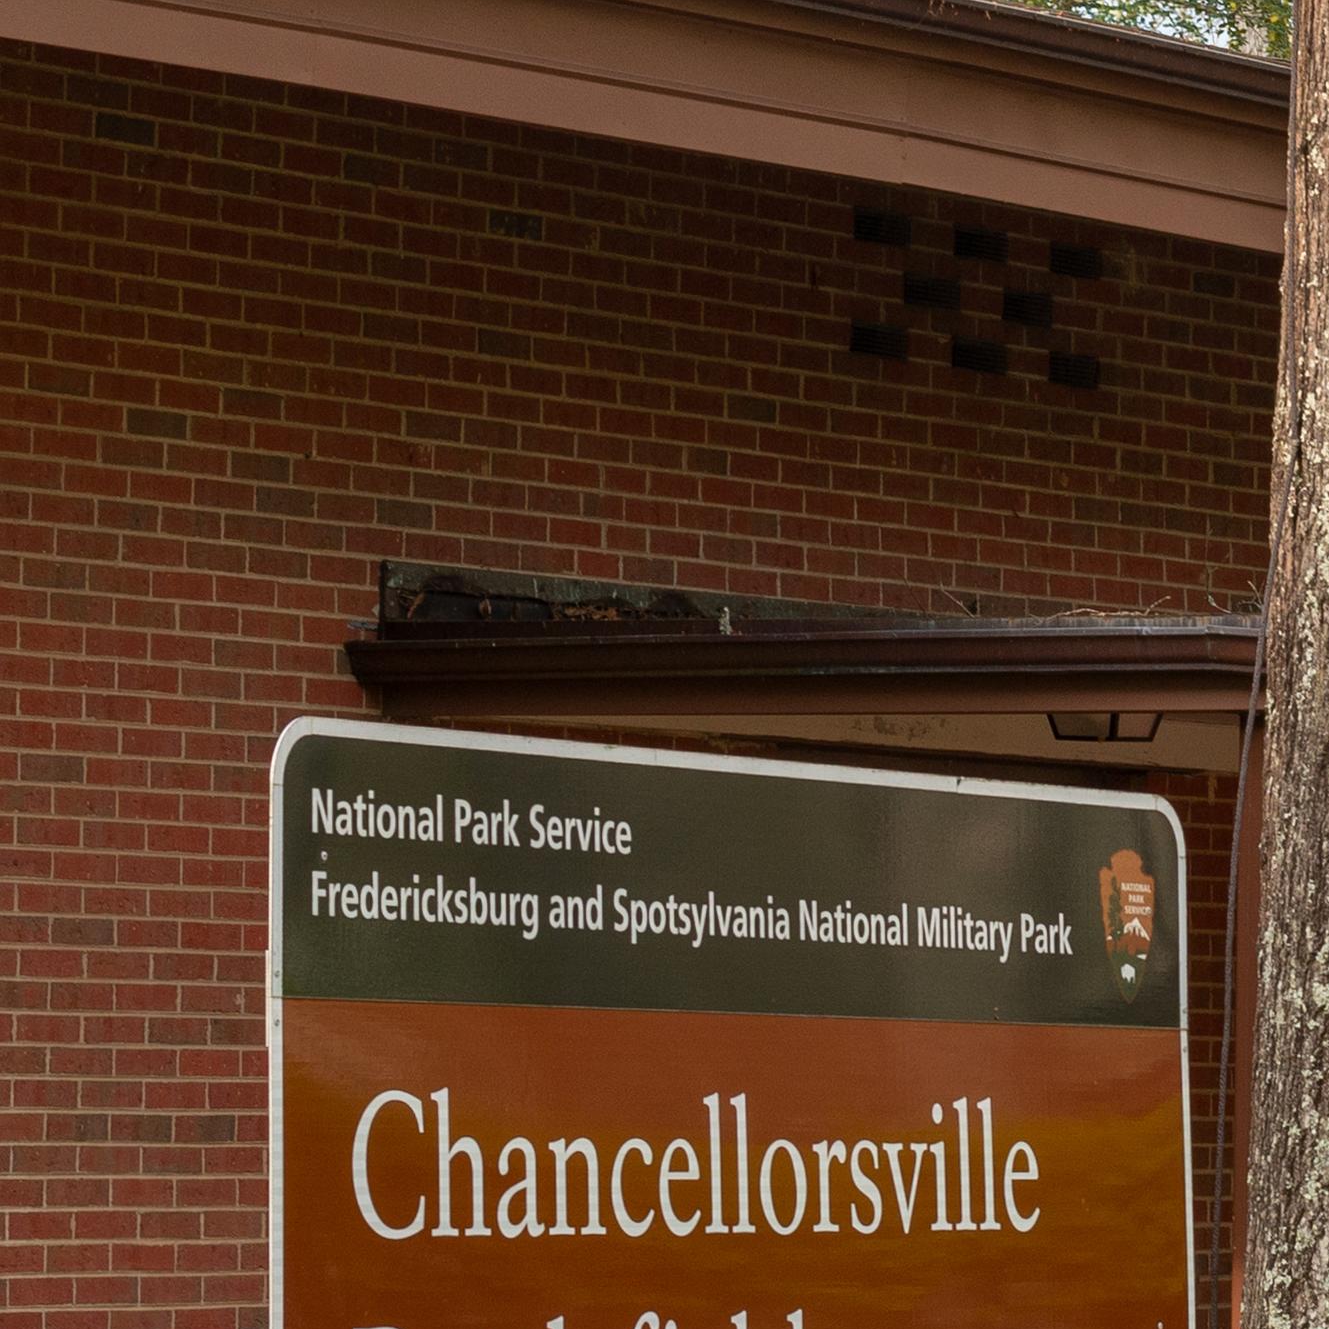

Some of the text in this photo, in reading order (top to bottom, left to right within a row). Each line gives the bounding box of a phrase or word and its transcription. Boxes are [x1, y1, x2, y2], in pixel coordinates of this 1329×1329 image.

[311, 787, 633, 855] National Park Service
[311, 870, 1074, 963] Fredericksburg and Spotsylvania National Military Park
[1120, 882, 1152, 893] NATIONAL
[1127, 894, 1145, 903] PARK
[351, 1086, 1041, 1241] Chancellorsville
